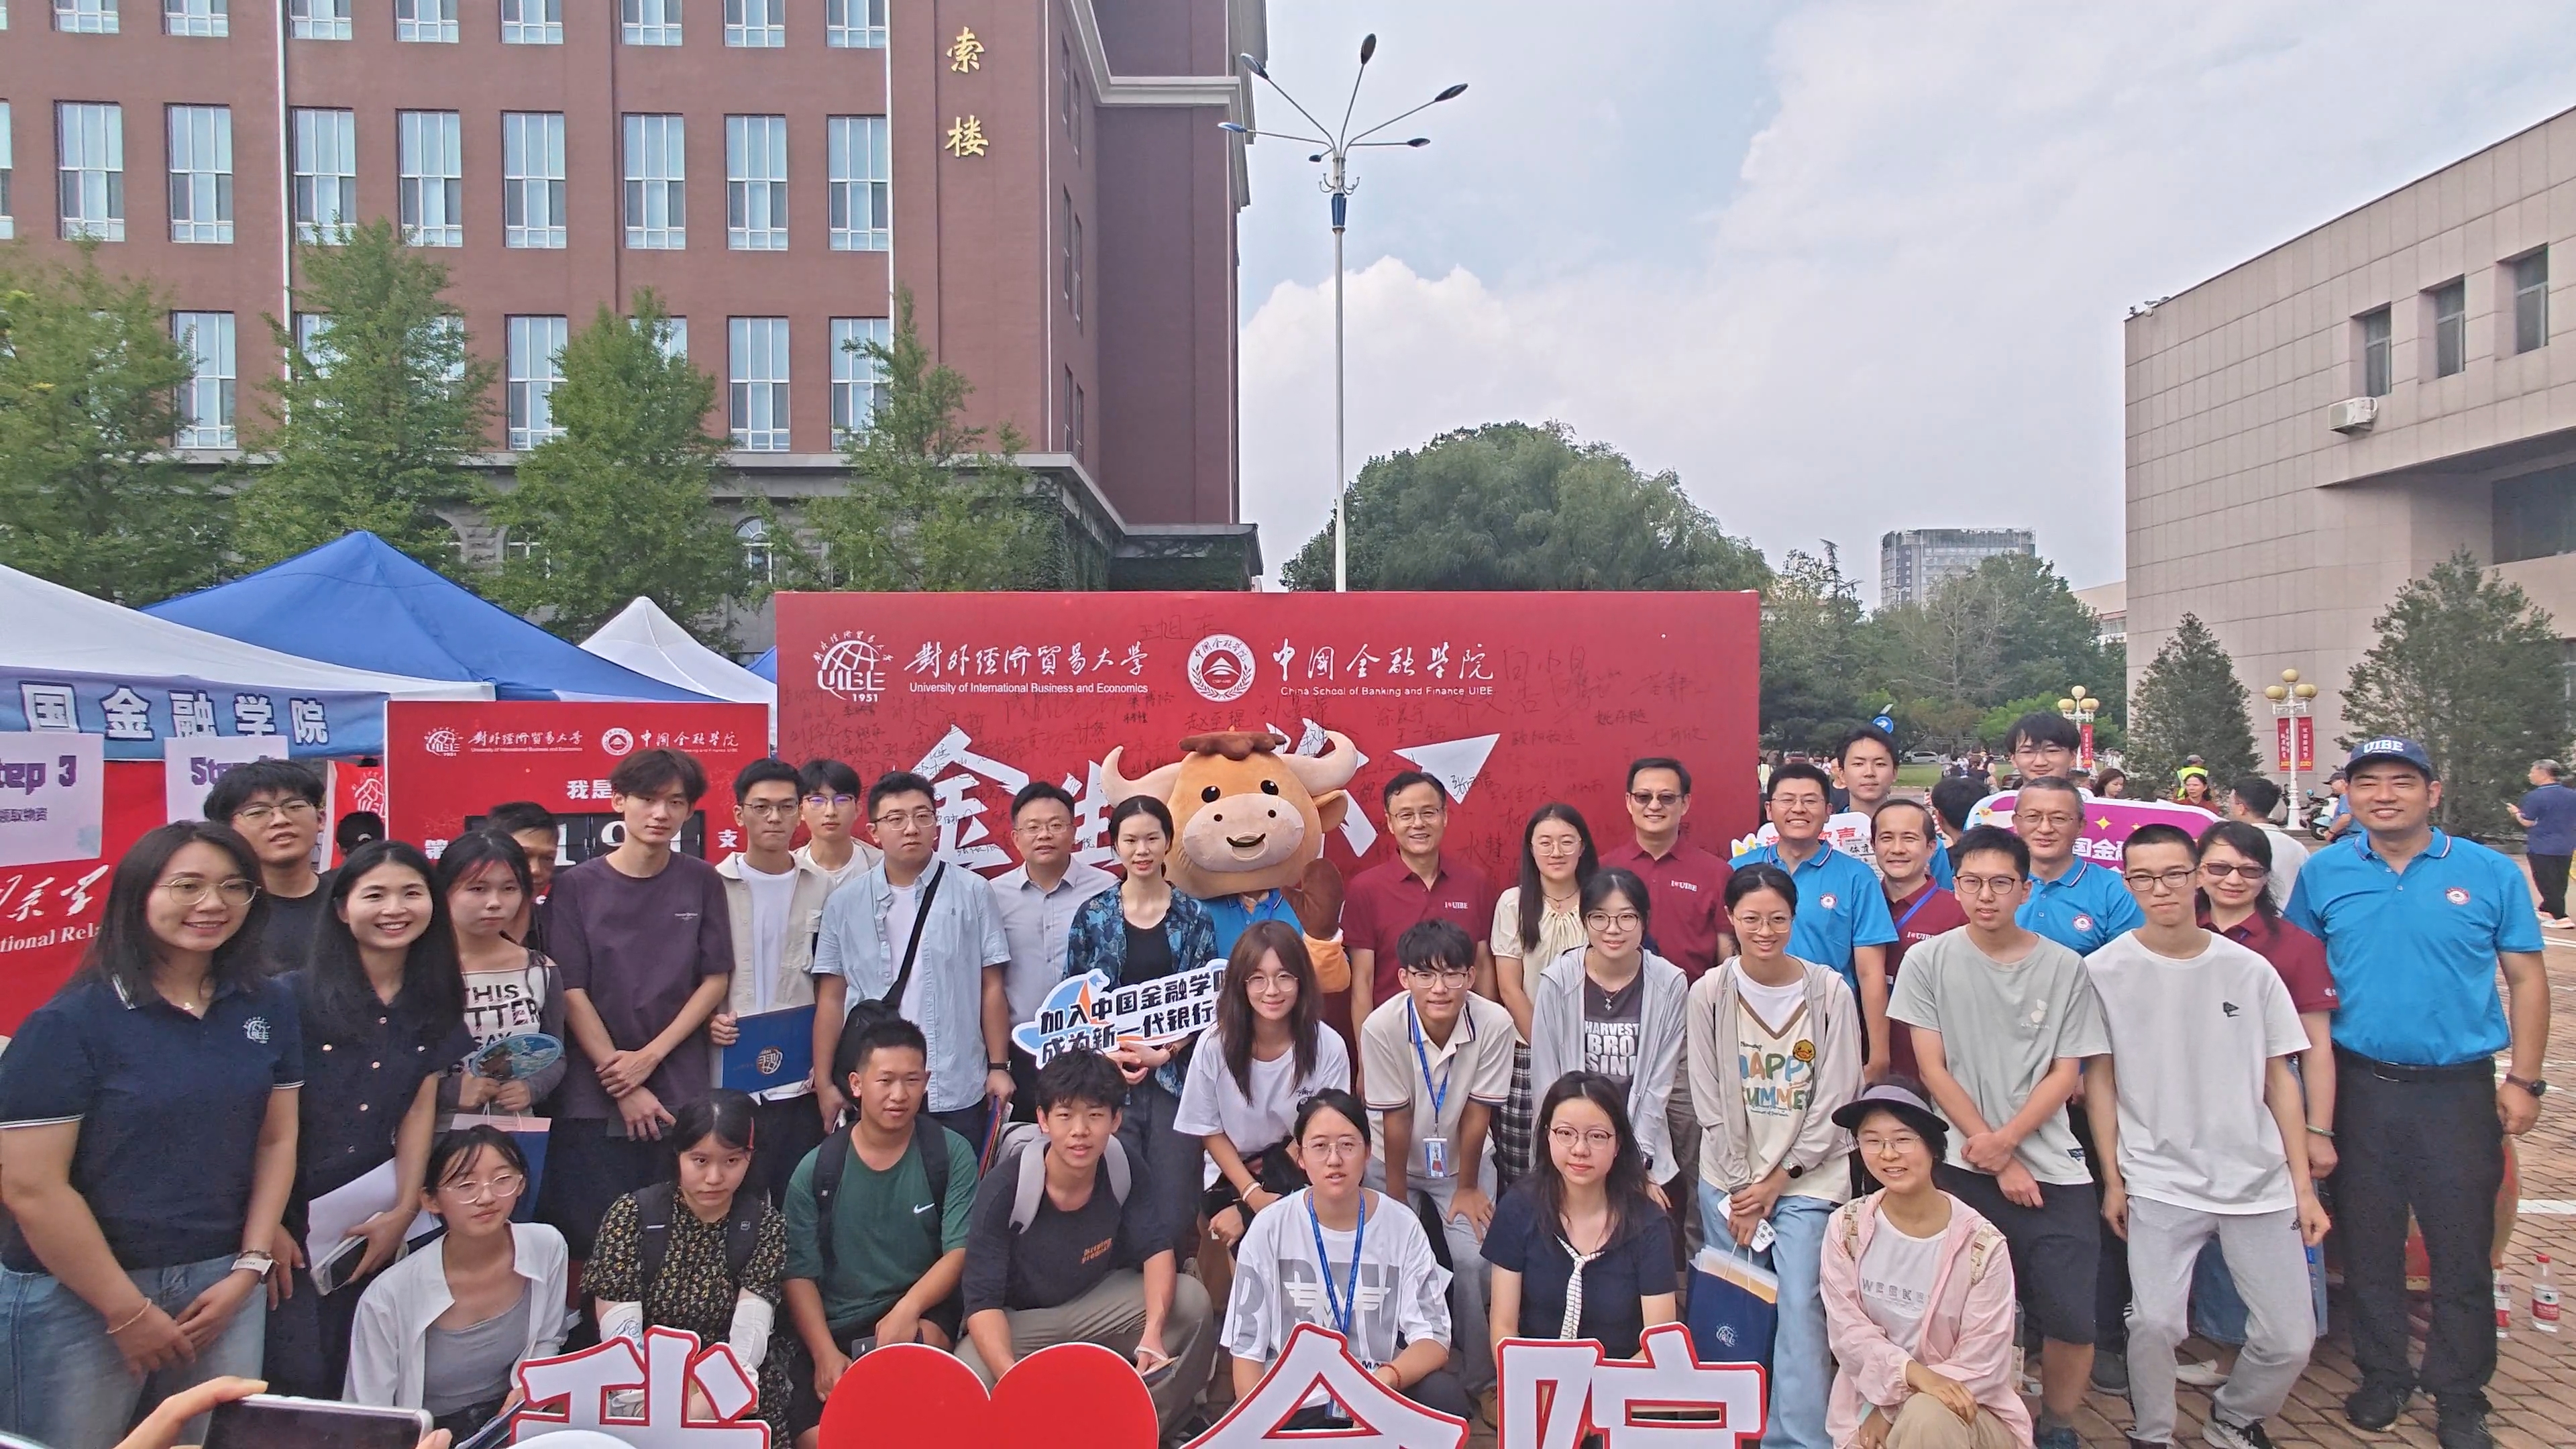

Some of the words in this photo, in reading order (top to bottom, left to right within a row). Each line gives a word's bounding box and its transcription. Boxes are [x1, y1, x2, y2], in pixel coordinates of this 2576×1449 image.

[910, 682, 956, 694] University
[959, 682, 969, 693] of
[971, 682, 1028, 694] International
[1031, 683, 1073, 694] Business
[1076, 682, 1094, 694] and
[1097, 683, 1148, 694] Economics
[1281, 686, 1309, 696] China
[1313, 686, 1346, 696] School
[1349, 686, 1359, 695] of
[1362, 686, 1401, 697] Banking
[1405, 687, 1422, 696] and
[1426, 686, 1464, 696] Finance
[1468, 686, 1493, 696] UIBE
[852, 694, 878, 702] 1951
[18, 680, 330, 745] 国金融学院
[2363, 739, 2404, 753] UIBE
[58, 755, 76, 787] 3
[717, 829, 738, 849] 支
[1584, 1020, 1640, 1036] HARVEST
[1741, 1085, 1813, 1112] UMME
